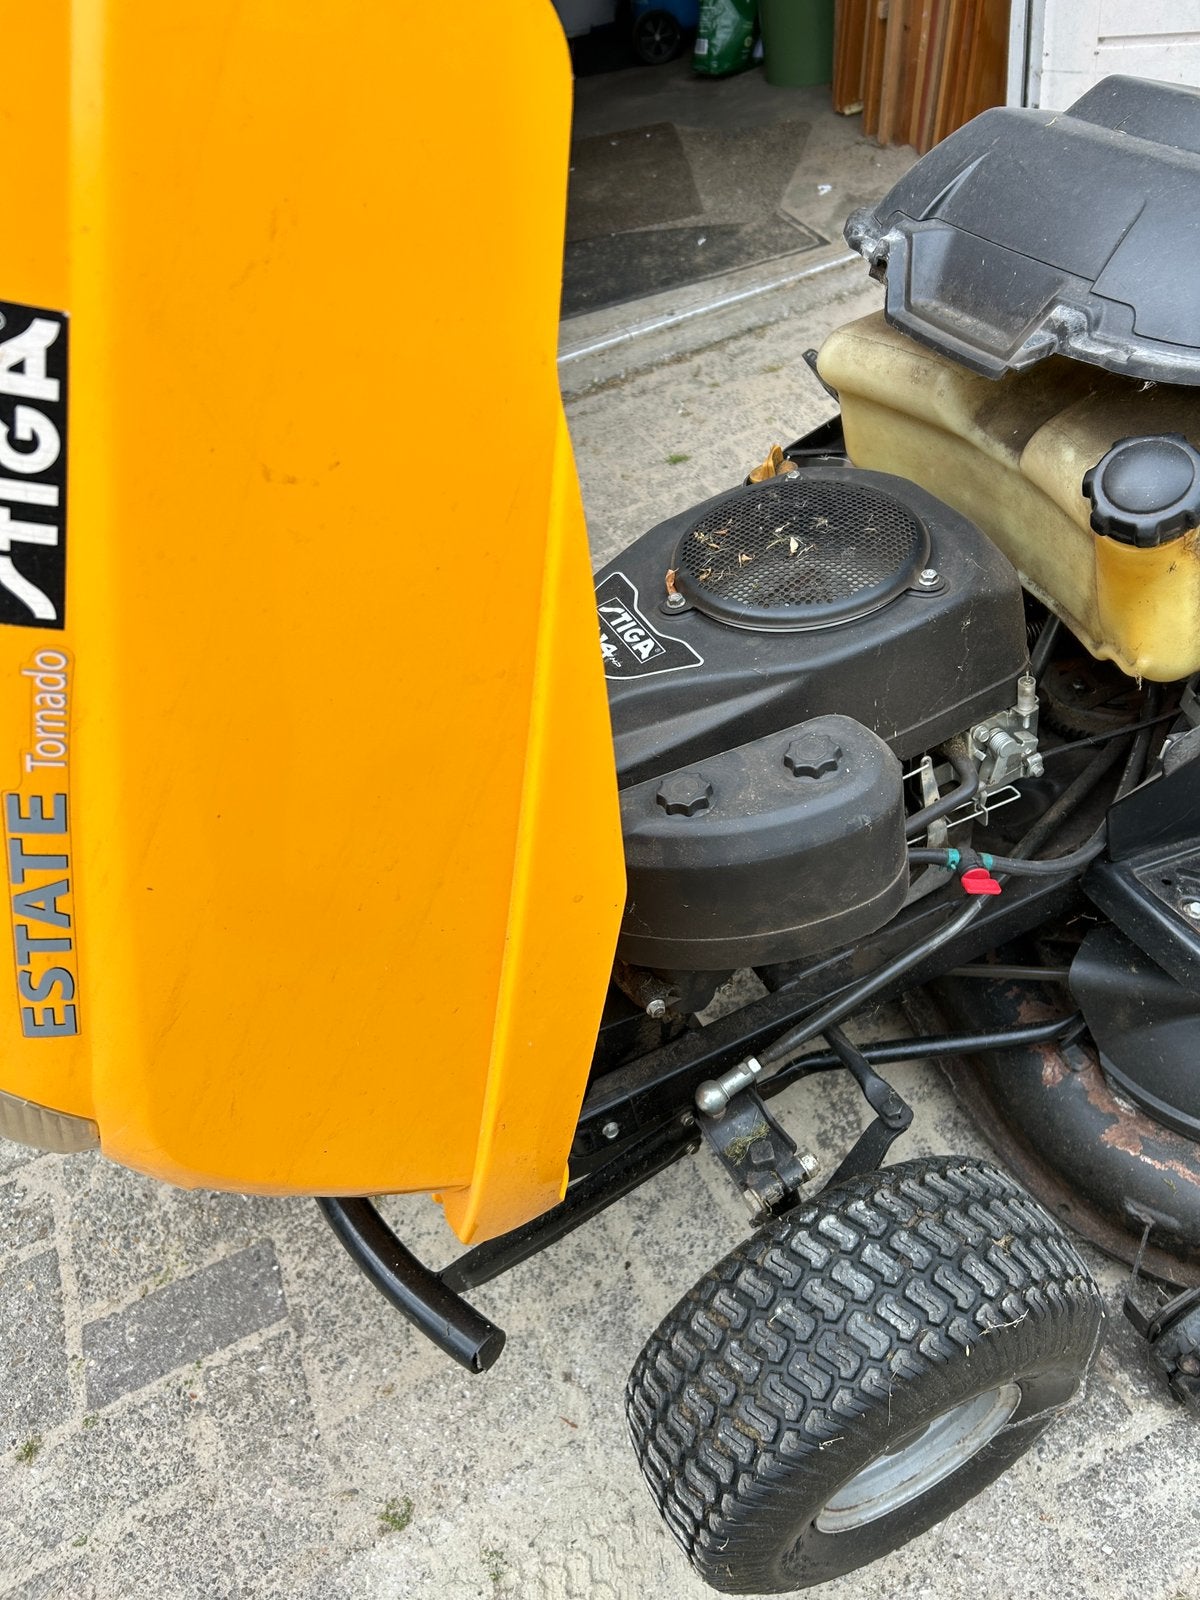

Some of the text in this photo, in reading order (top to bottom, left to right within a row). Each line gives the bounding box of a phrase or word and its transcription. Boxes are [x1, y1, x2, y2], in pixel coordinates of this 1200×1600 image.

[0, 318, 61, 620] STIGA
[598, 606, 655, 660] STIGA
[7, 649, 78, 1037] ESTATE Tornado
